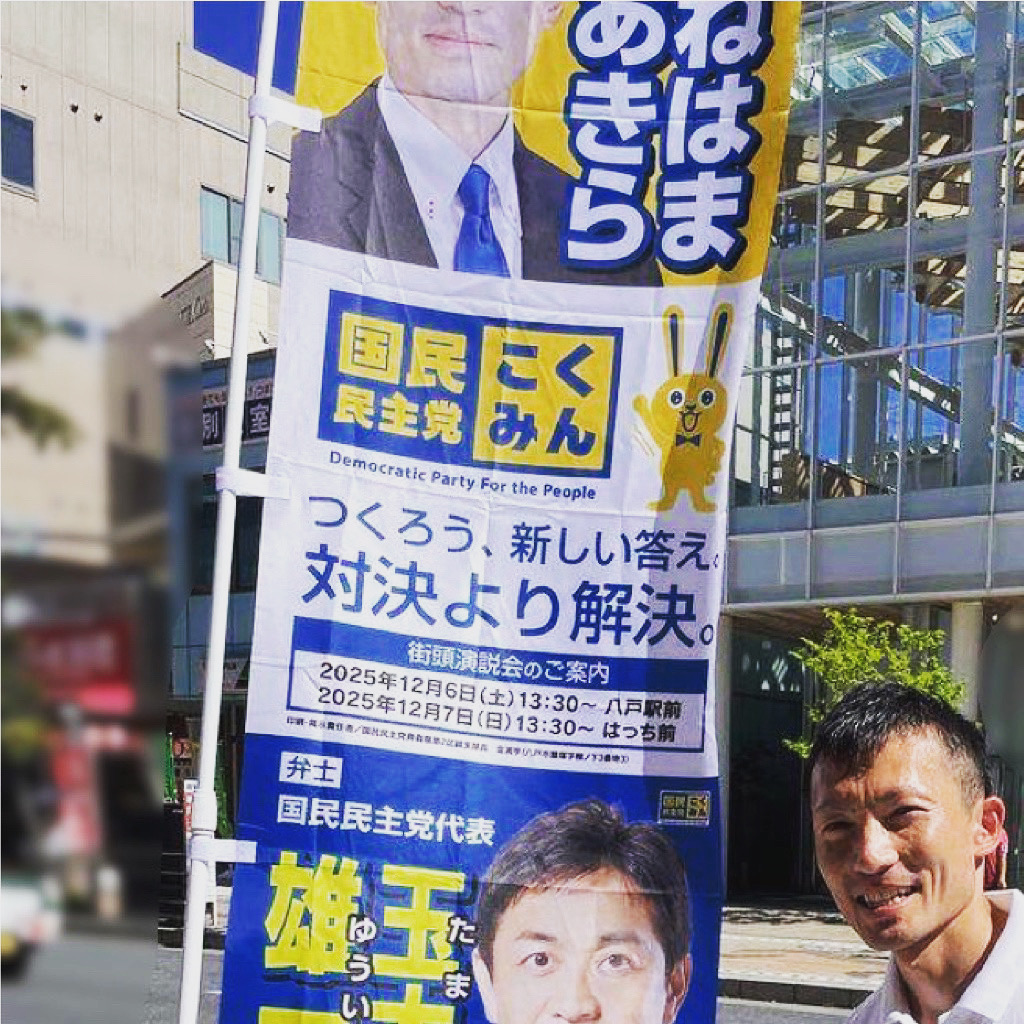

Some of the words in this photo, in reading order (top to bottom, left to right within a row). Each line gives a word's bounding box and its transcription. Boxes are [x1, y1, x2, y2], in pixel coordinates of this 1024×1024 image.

[340, 312, 468, 394] 国民
[500, 342, 595, 396] こく
[333, 384, 463, 443] 民主党
[489, 403, 595, 454] みん
[330, 451, 425, 481] Democratic
[431, 470, 476, 493] Party
[481, 475, 507, 494] For
[512, 479, 539, 497] the
[544, 482, 596, 502] People
[303, 544, 714, 648] 対決より解決。
[407, 643, 610, 685] 街頭演説会のご案内
[286, 755, 337, 783] 弁士
[277, 794, 496, 847] 国民民主党代表
